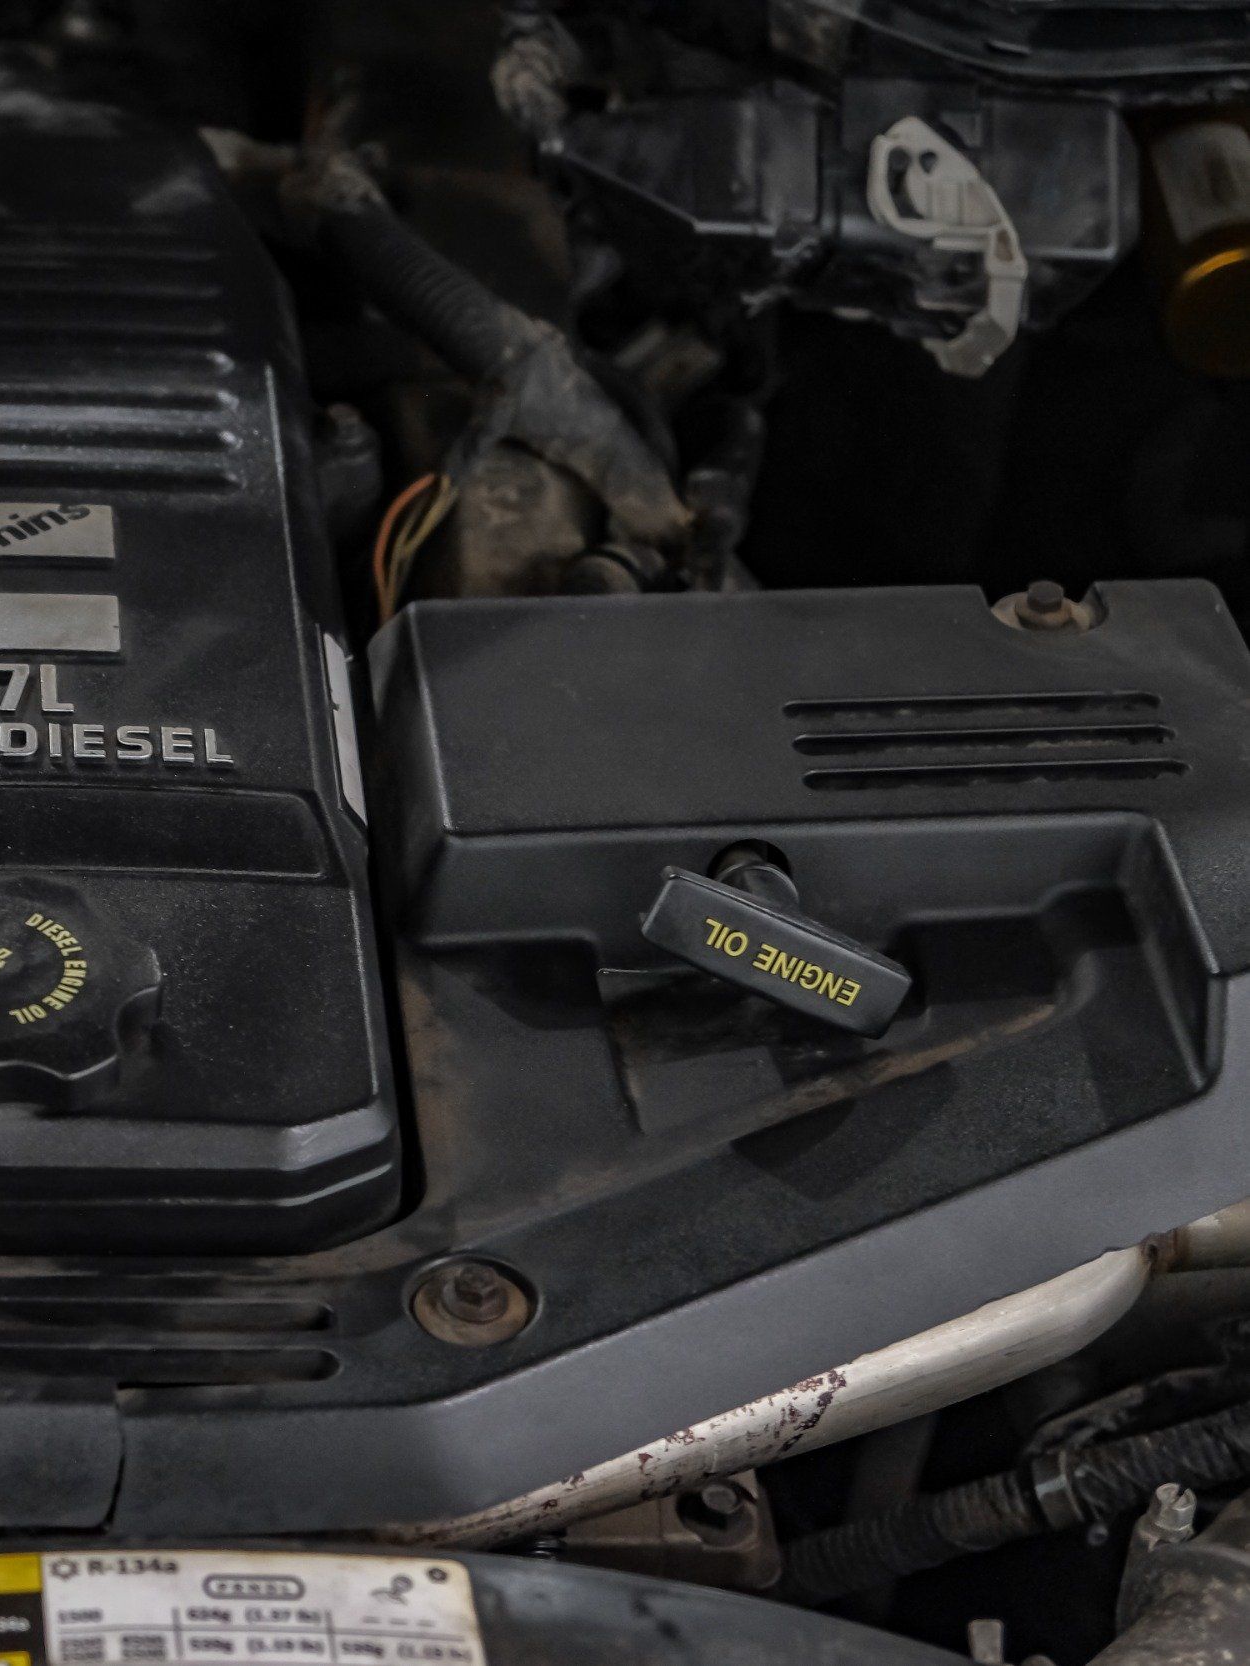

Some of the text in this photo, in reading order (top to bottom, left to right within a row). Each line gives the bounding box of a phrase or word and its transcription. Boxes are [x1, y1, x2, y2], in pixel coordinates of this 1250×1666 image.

[0, 722, 234, 765] DIESEL
[8, 912, 87, 1025] DIESEL ENGINE OIL
[705, 918, 862, 1007] ENGINE OIL
[87, 1558, 180, 1576] R-134a
